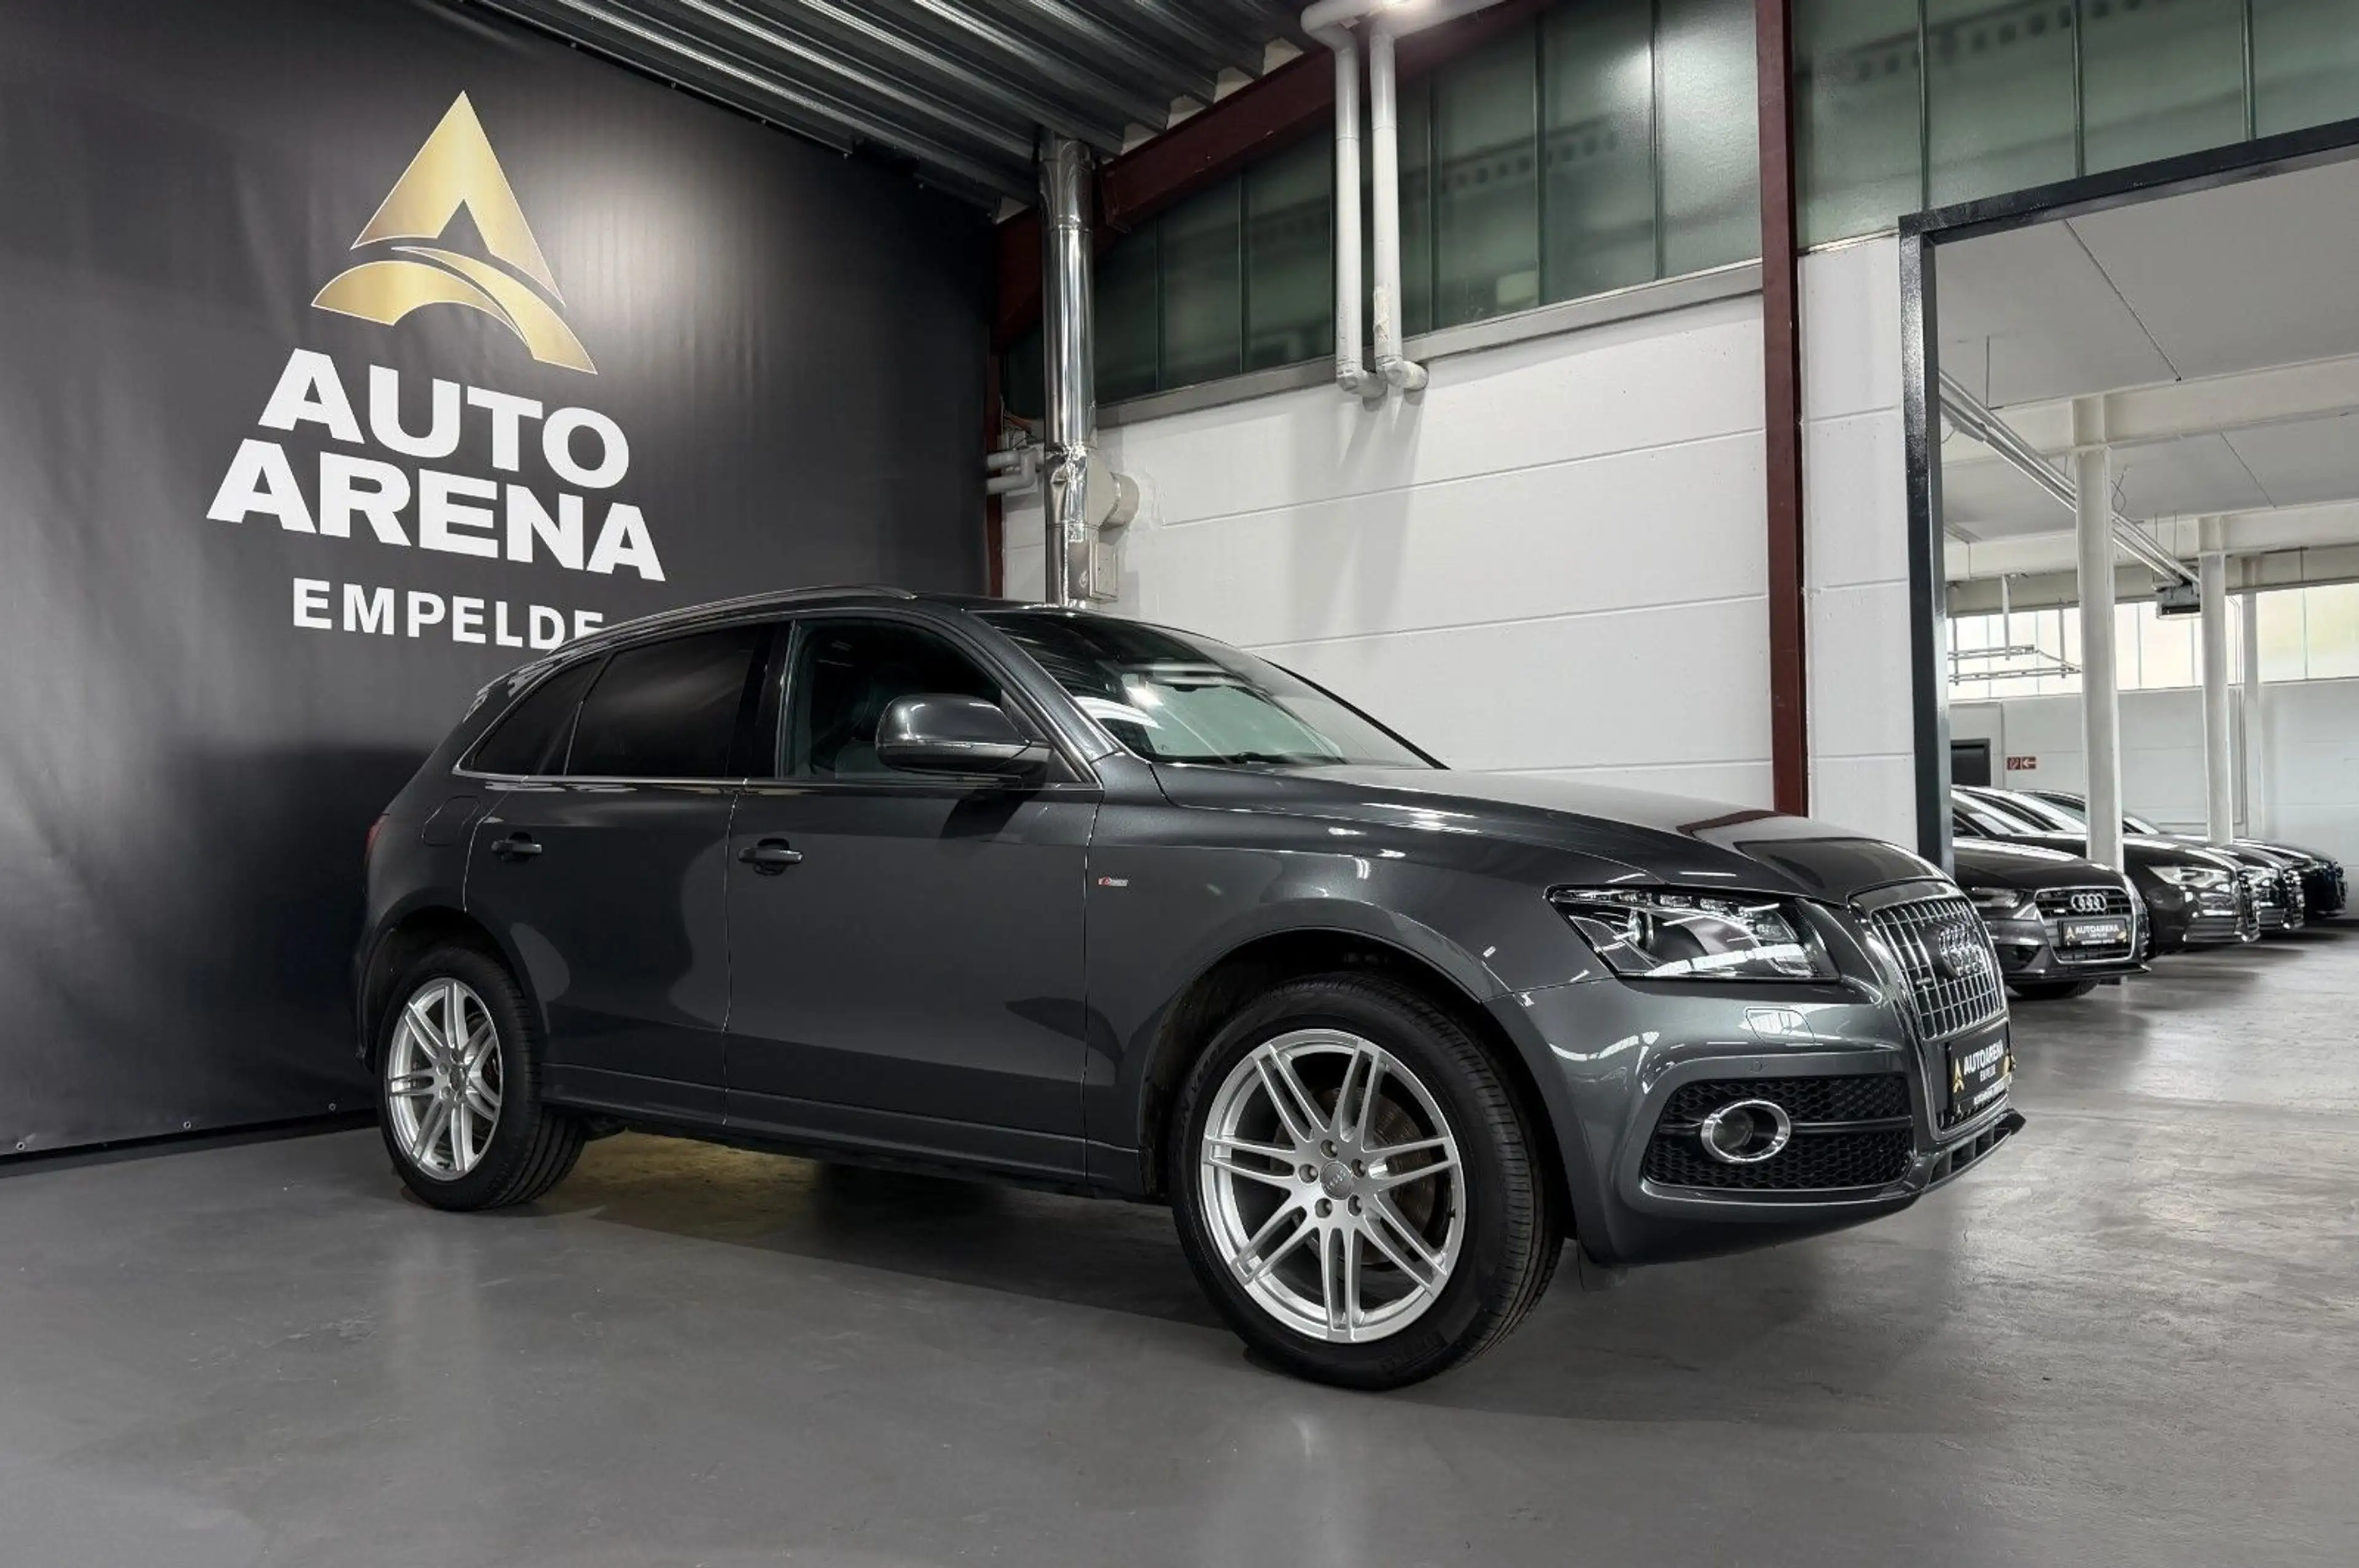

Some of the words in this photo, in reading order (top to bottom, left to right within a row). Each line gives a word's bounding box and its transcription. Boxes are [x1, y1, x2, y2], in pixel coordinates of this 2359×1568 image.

[259, 348, 629, 488] AUTO
[206, 439, 666, 582] ARENA
[1963, 1039, 2003, 1075] AUTOARENA
